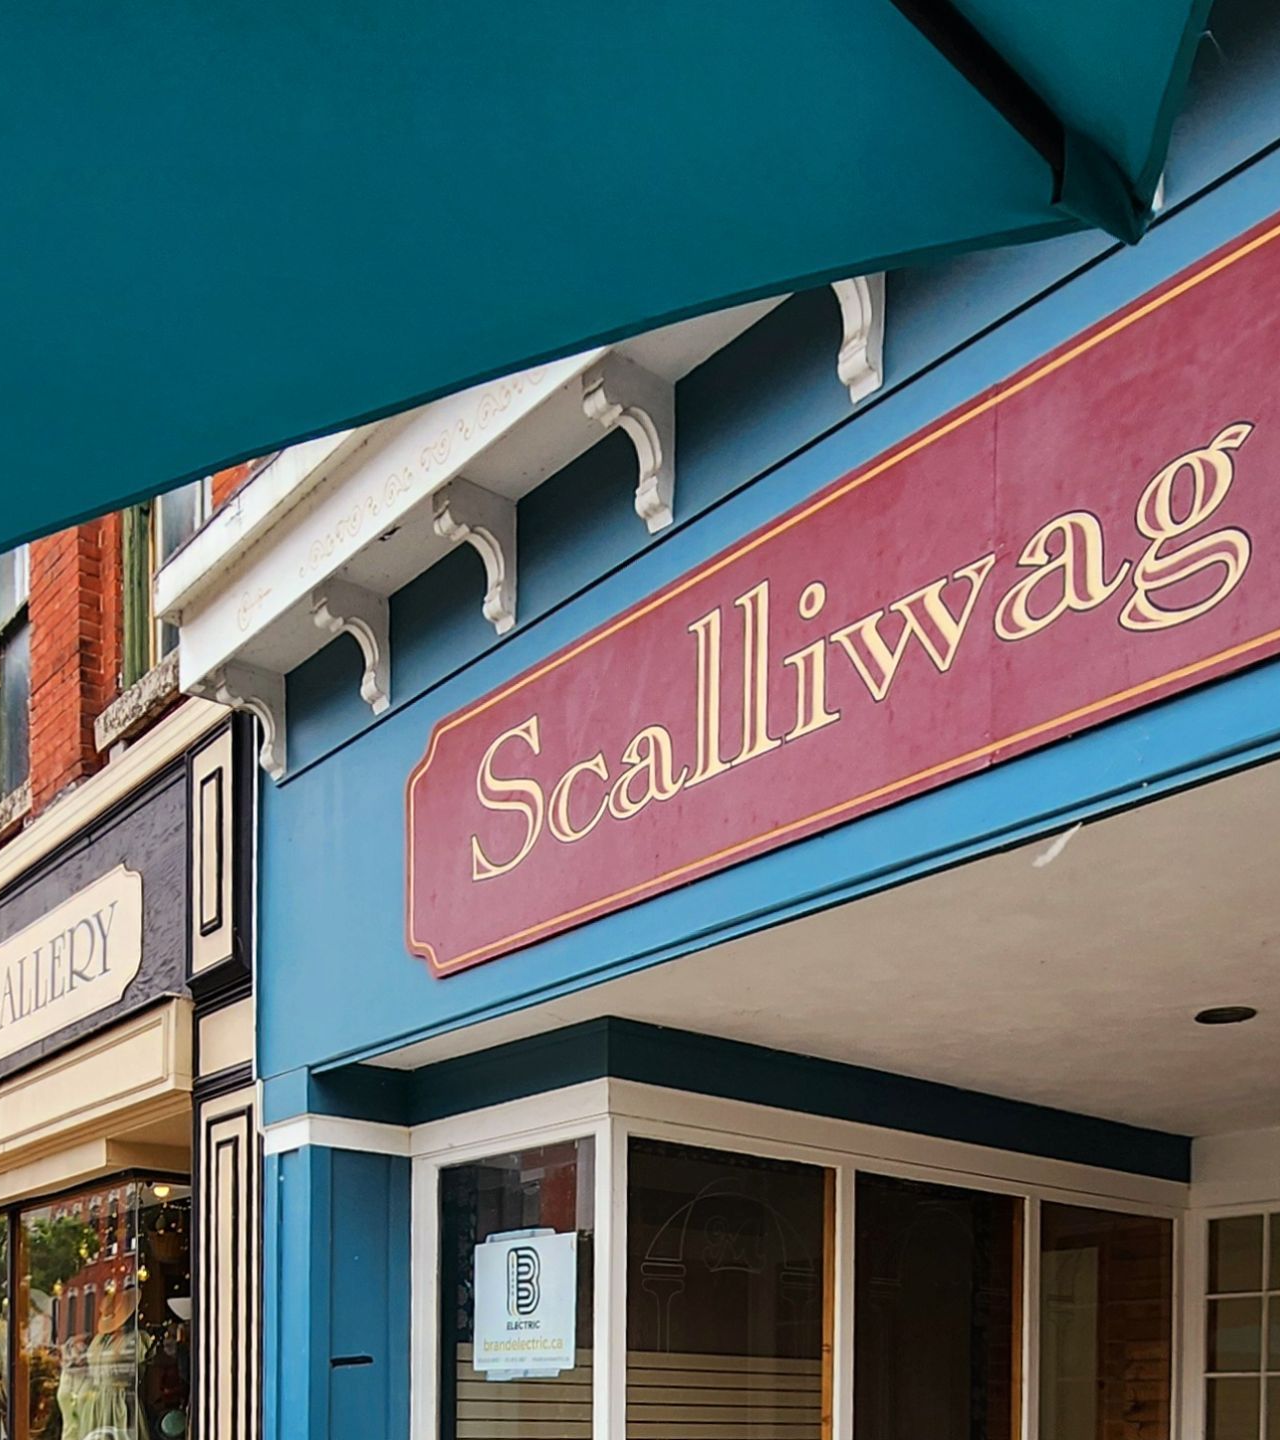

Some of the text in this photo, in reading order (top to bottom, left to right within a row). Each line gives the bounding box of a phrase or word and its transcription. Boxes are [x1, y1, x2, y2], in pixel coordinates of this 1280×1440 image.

[470, 419, 1256, 884] Scalliwag
[505, 1320, 541, 1331] ELECTRIC
[483, 1336, 564, 1352] brandelectric.ca
